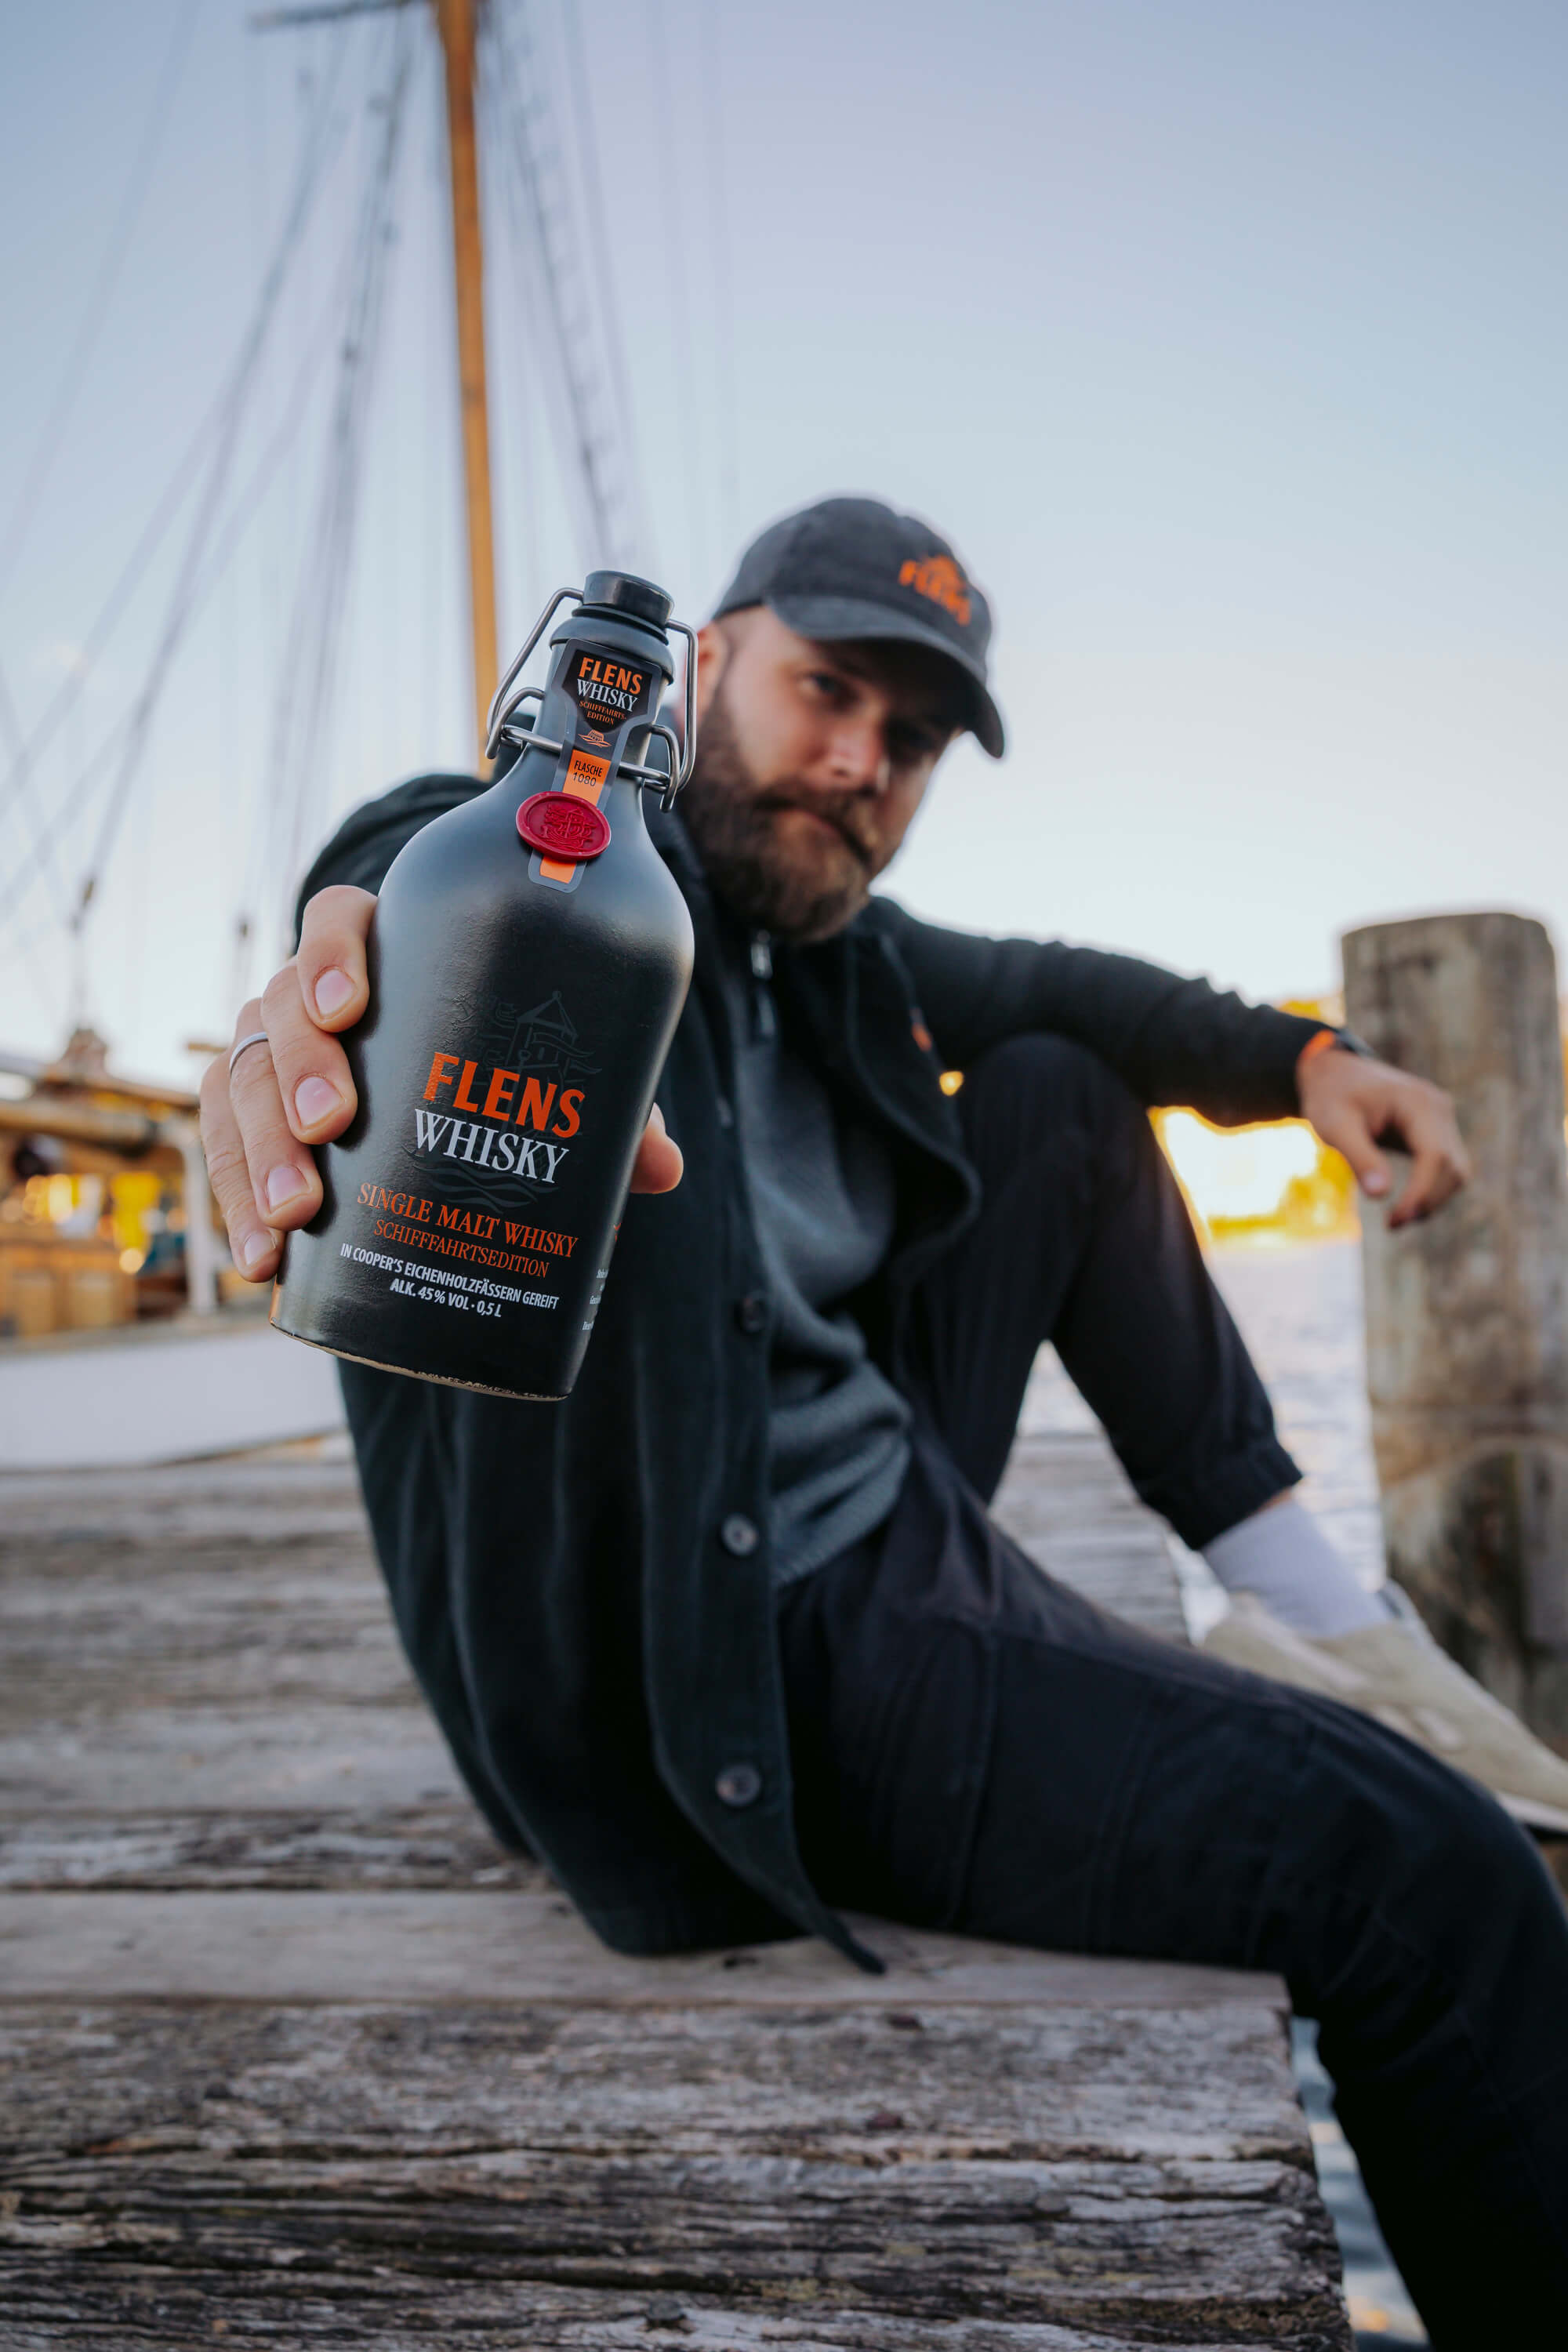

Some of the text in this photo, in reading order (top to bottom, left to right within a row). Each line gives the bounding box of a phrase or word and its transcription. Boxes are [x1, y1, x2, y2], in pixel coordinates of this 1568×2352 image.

[579, 657, 642, 695] FLENS
[577, 679, 638, 712] WHISKY
[586, 711, 614, 725] EDITION
[573, 772, 596, 786] 1080
[574, 760, 603, 778] FLASCHE
[423, 1051, 586, 1138] FLENS
[415, 1109, 569, 1183] WHISKY
[358, 1182, 433, 1222] SINGLE
[435, 1204, 500, 1240] MALT
[504, 1221, 579, 1258] WHISKY
[374, 1219, 550, 1278] SCHIFFFAHRTSEDITION
[340, 1243, 560, 1310] IN COOPER'S EICHENHOLZFÄSSERN GEREIFT
[389, 1278, 416, 1297] ALK.
